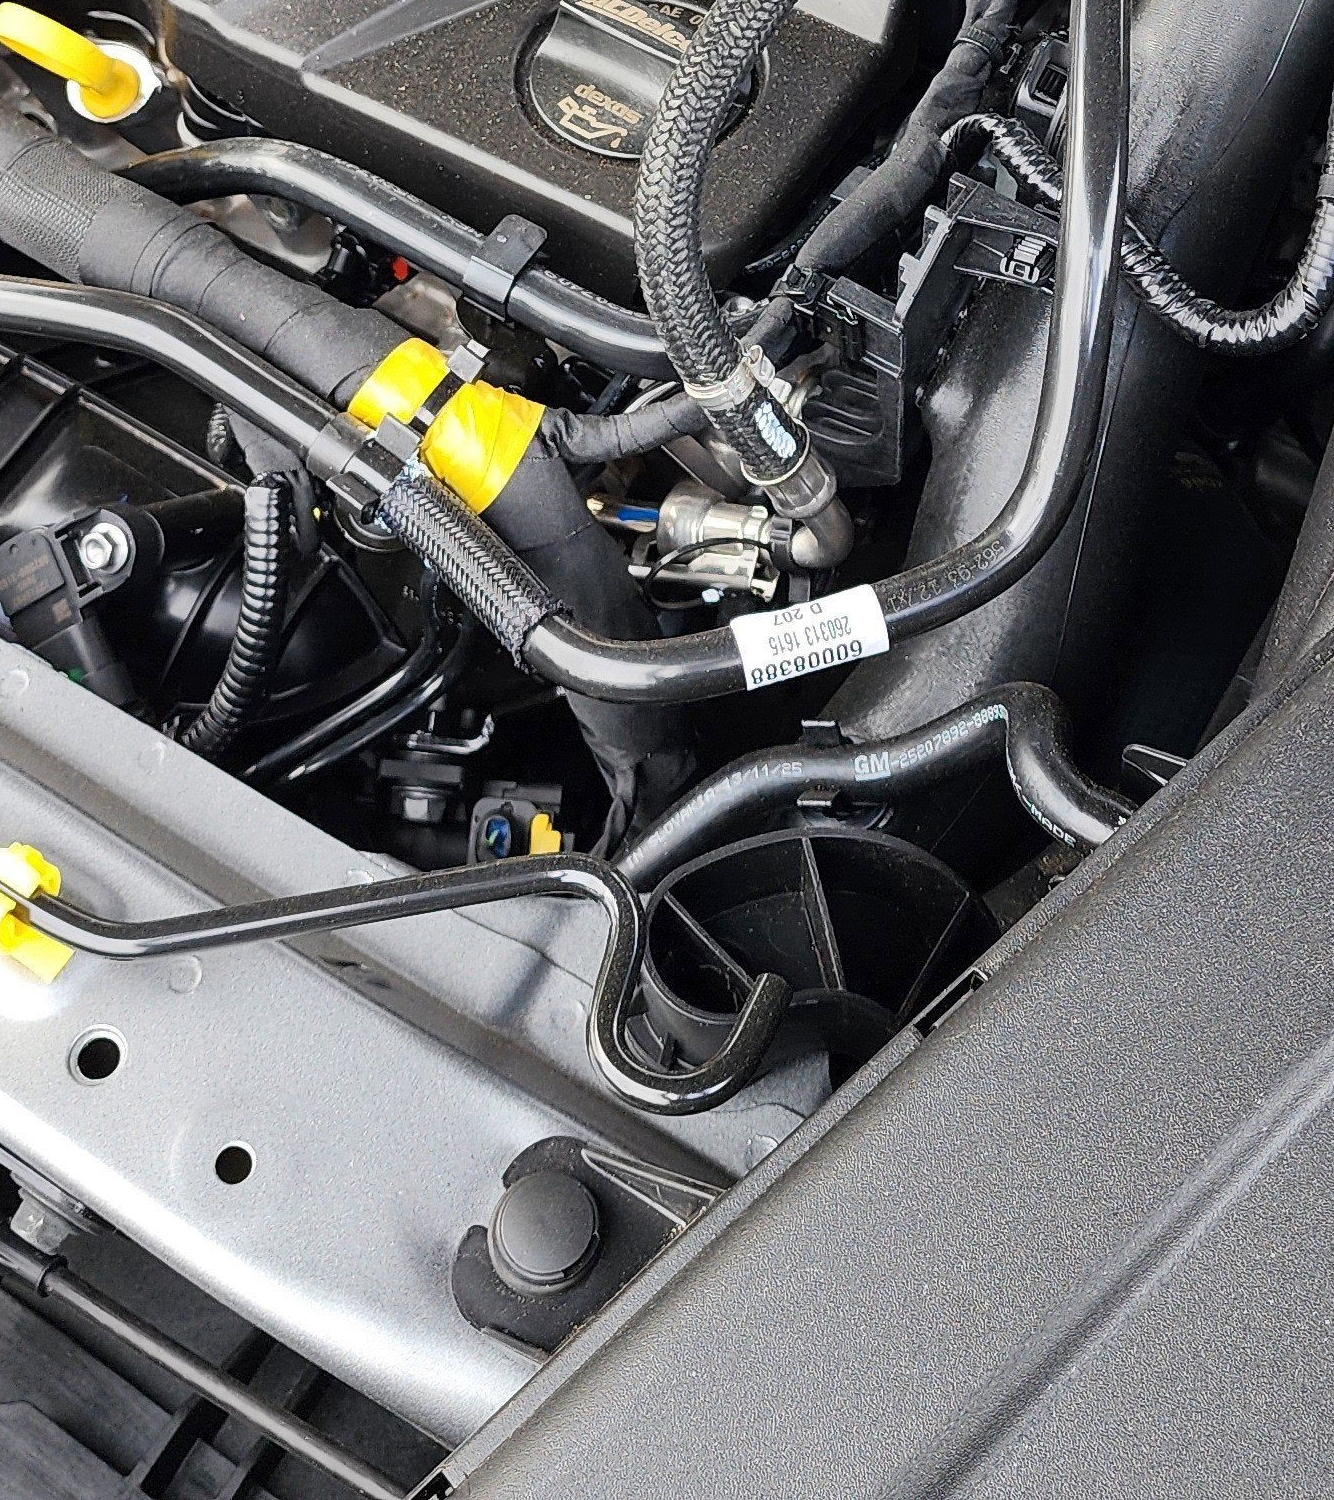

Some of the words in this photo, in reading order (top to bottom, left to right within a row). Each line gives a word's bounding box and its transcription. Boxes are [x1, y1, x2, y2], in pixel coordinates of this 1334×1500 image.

[573, 83, 646, 125] dexos
[773, 607, 804, 626] 207
[815, 602, 823, 615] D
[768, 631, 802, 657] 1615
[806, 615, 852, 646] 260313
[750, 639, 863, 685] 60008388
